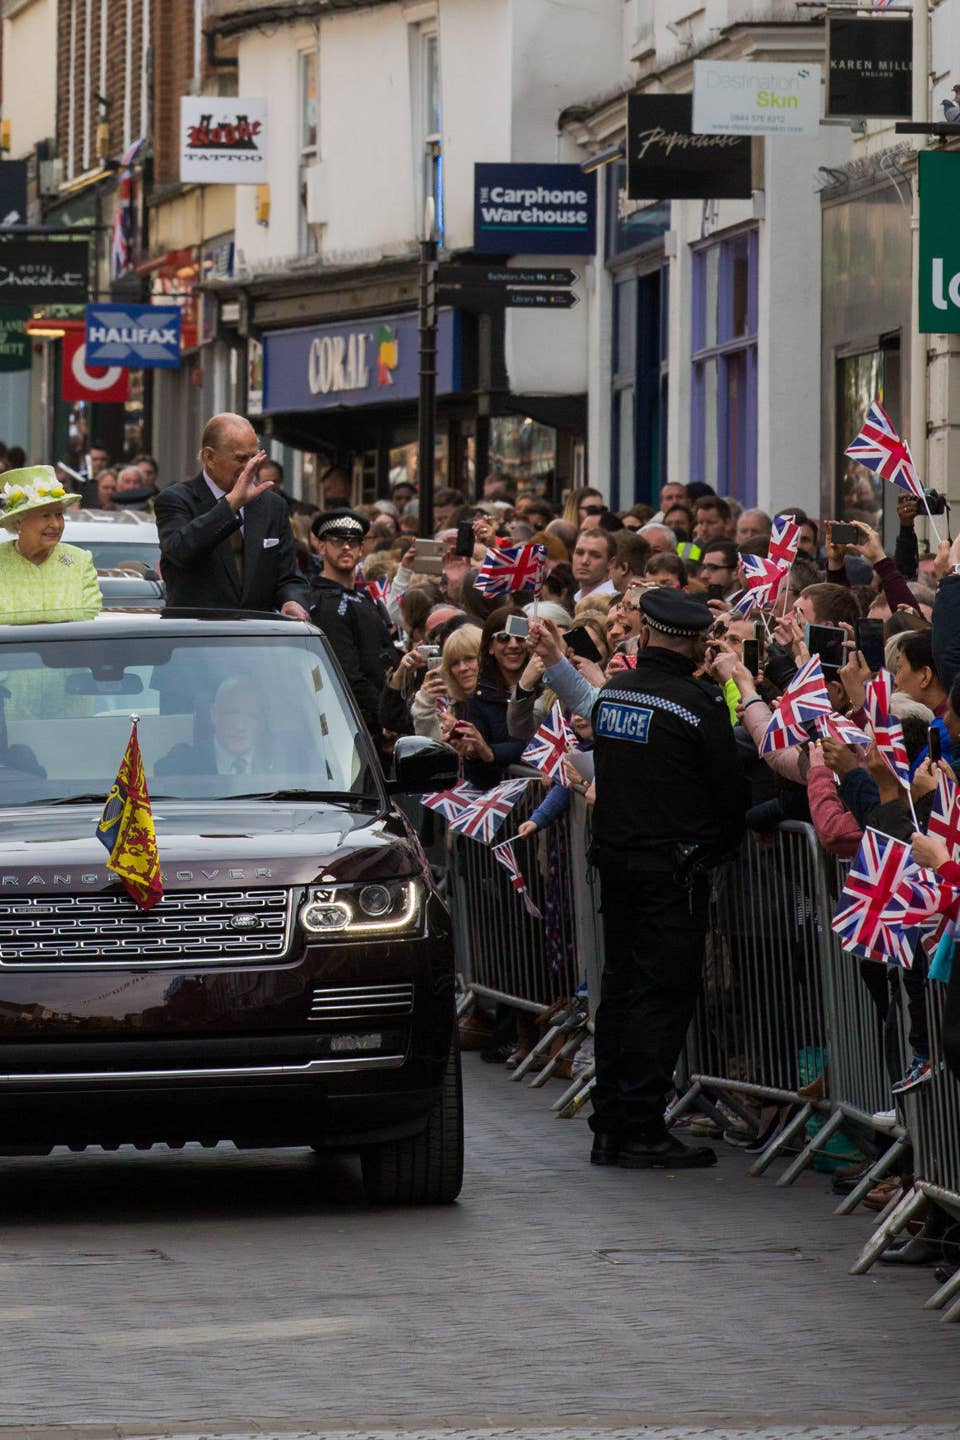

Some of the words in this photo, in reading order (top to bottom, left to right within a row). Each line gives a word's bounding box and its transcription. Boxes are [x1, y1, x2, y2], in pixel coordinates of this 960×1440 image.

[830, 60, 872, 70] KAREN
[706, 71, 800, 90] Destination
[756, 90, 799, 109] Skin
[184, 153, 263, 162] TATTOO
[490, 187, 588, 207] Carphone
[482, 208, 588, 224] Warehouse
[88, 327, 177, 344] HALIFAX
[308, 333, 369, 394] CORAL
[599, 707, 649, 737] POLICE
[1, 874, 122, 887] RANGE
